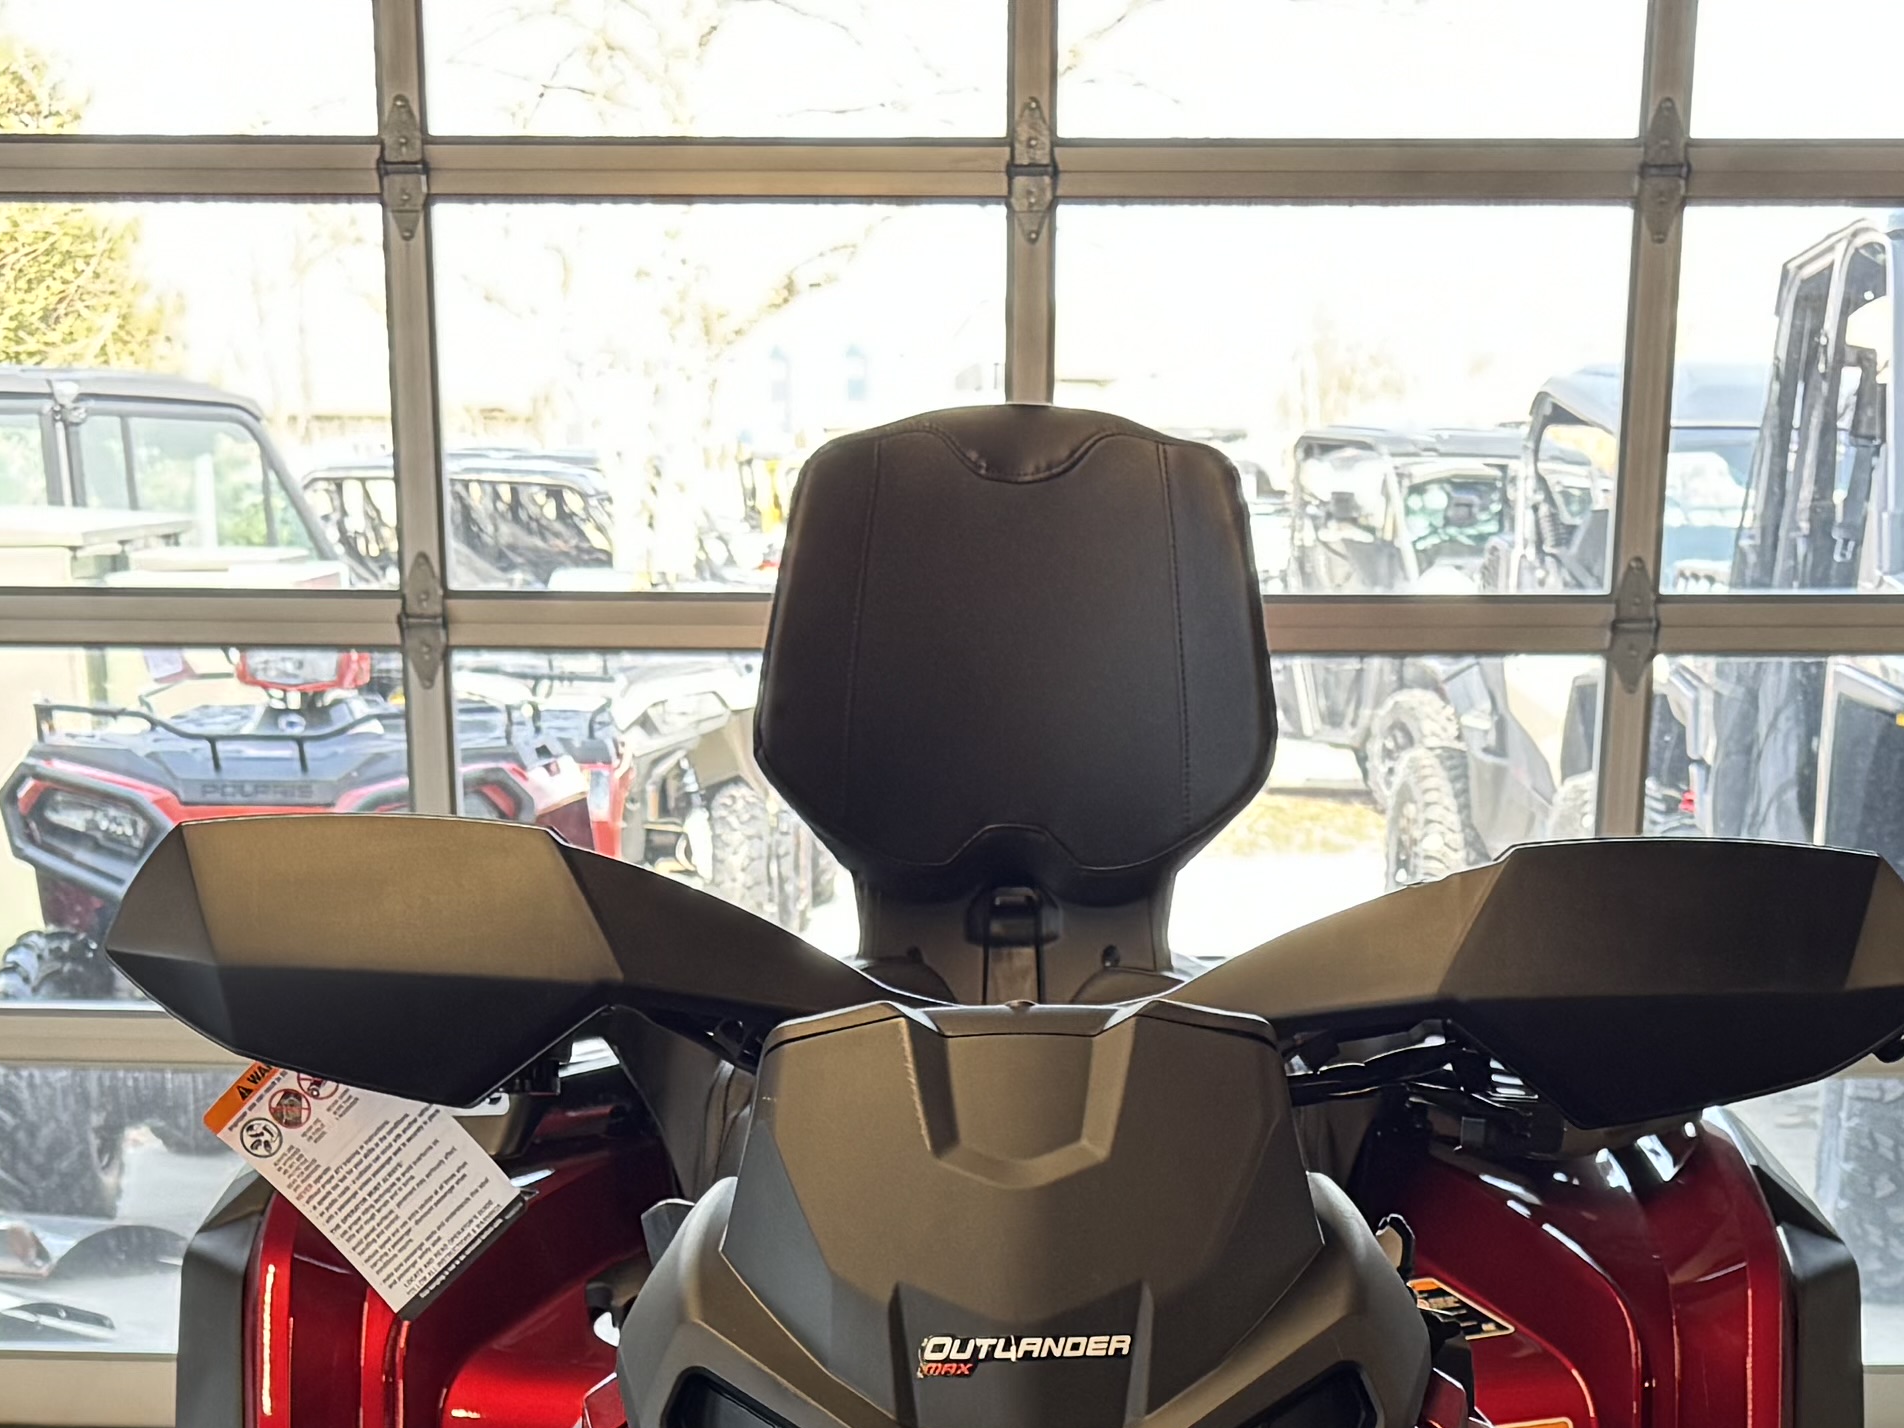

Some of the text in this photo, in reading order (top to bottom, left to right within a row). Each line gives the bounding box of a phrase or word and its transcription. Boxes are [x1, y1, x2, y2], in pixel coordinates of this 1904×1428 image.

[200, 783, 314, 799] POLARIS
[922, 1334, 1132, 1362] OUTLANDER
[923, 1362, 973, 1376] MAX
